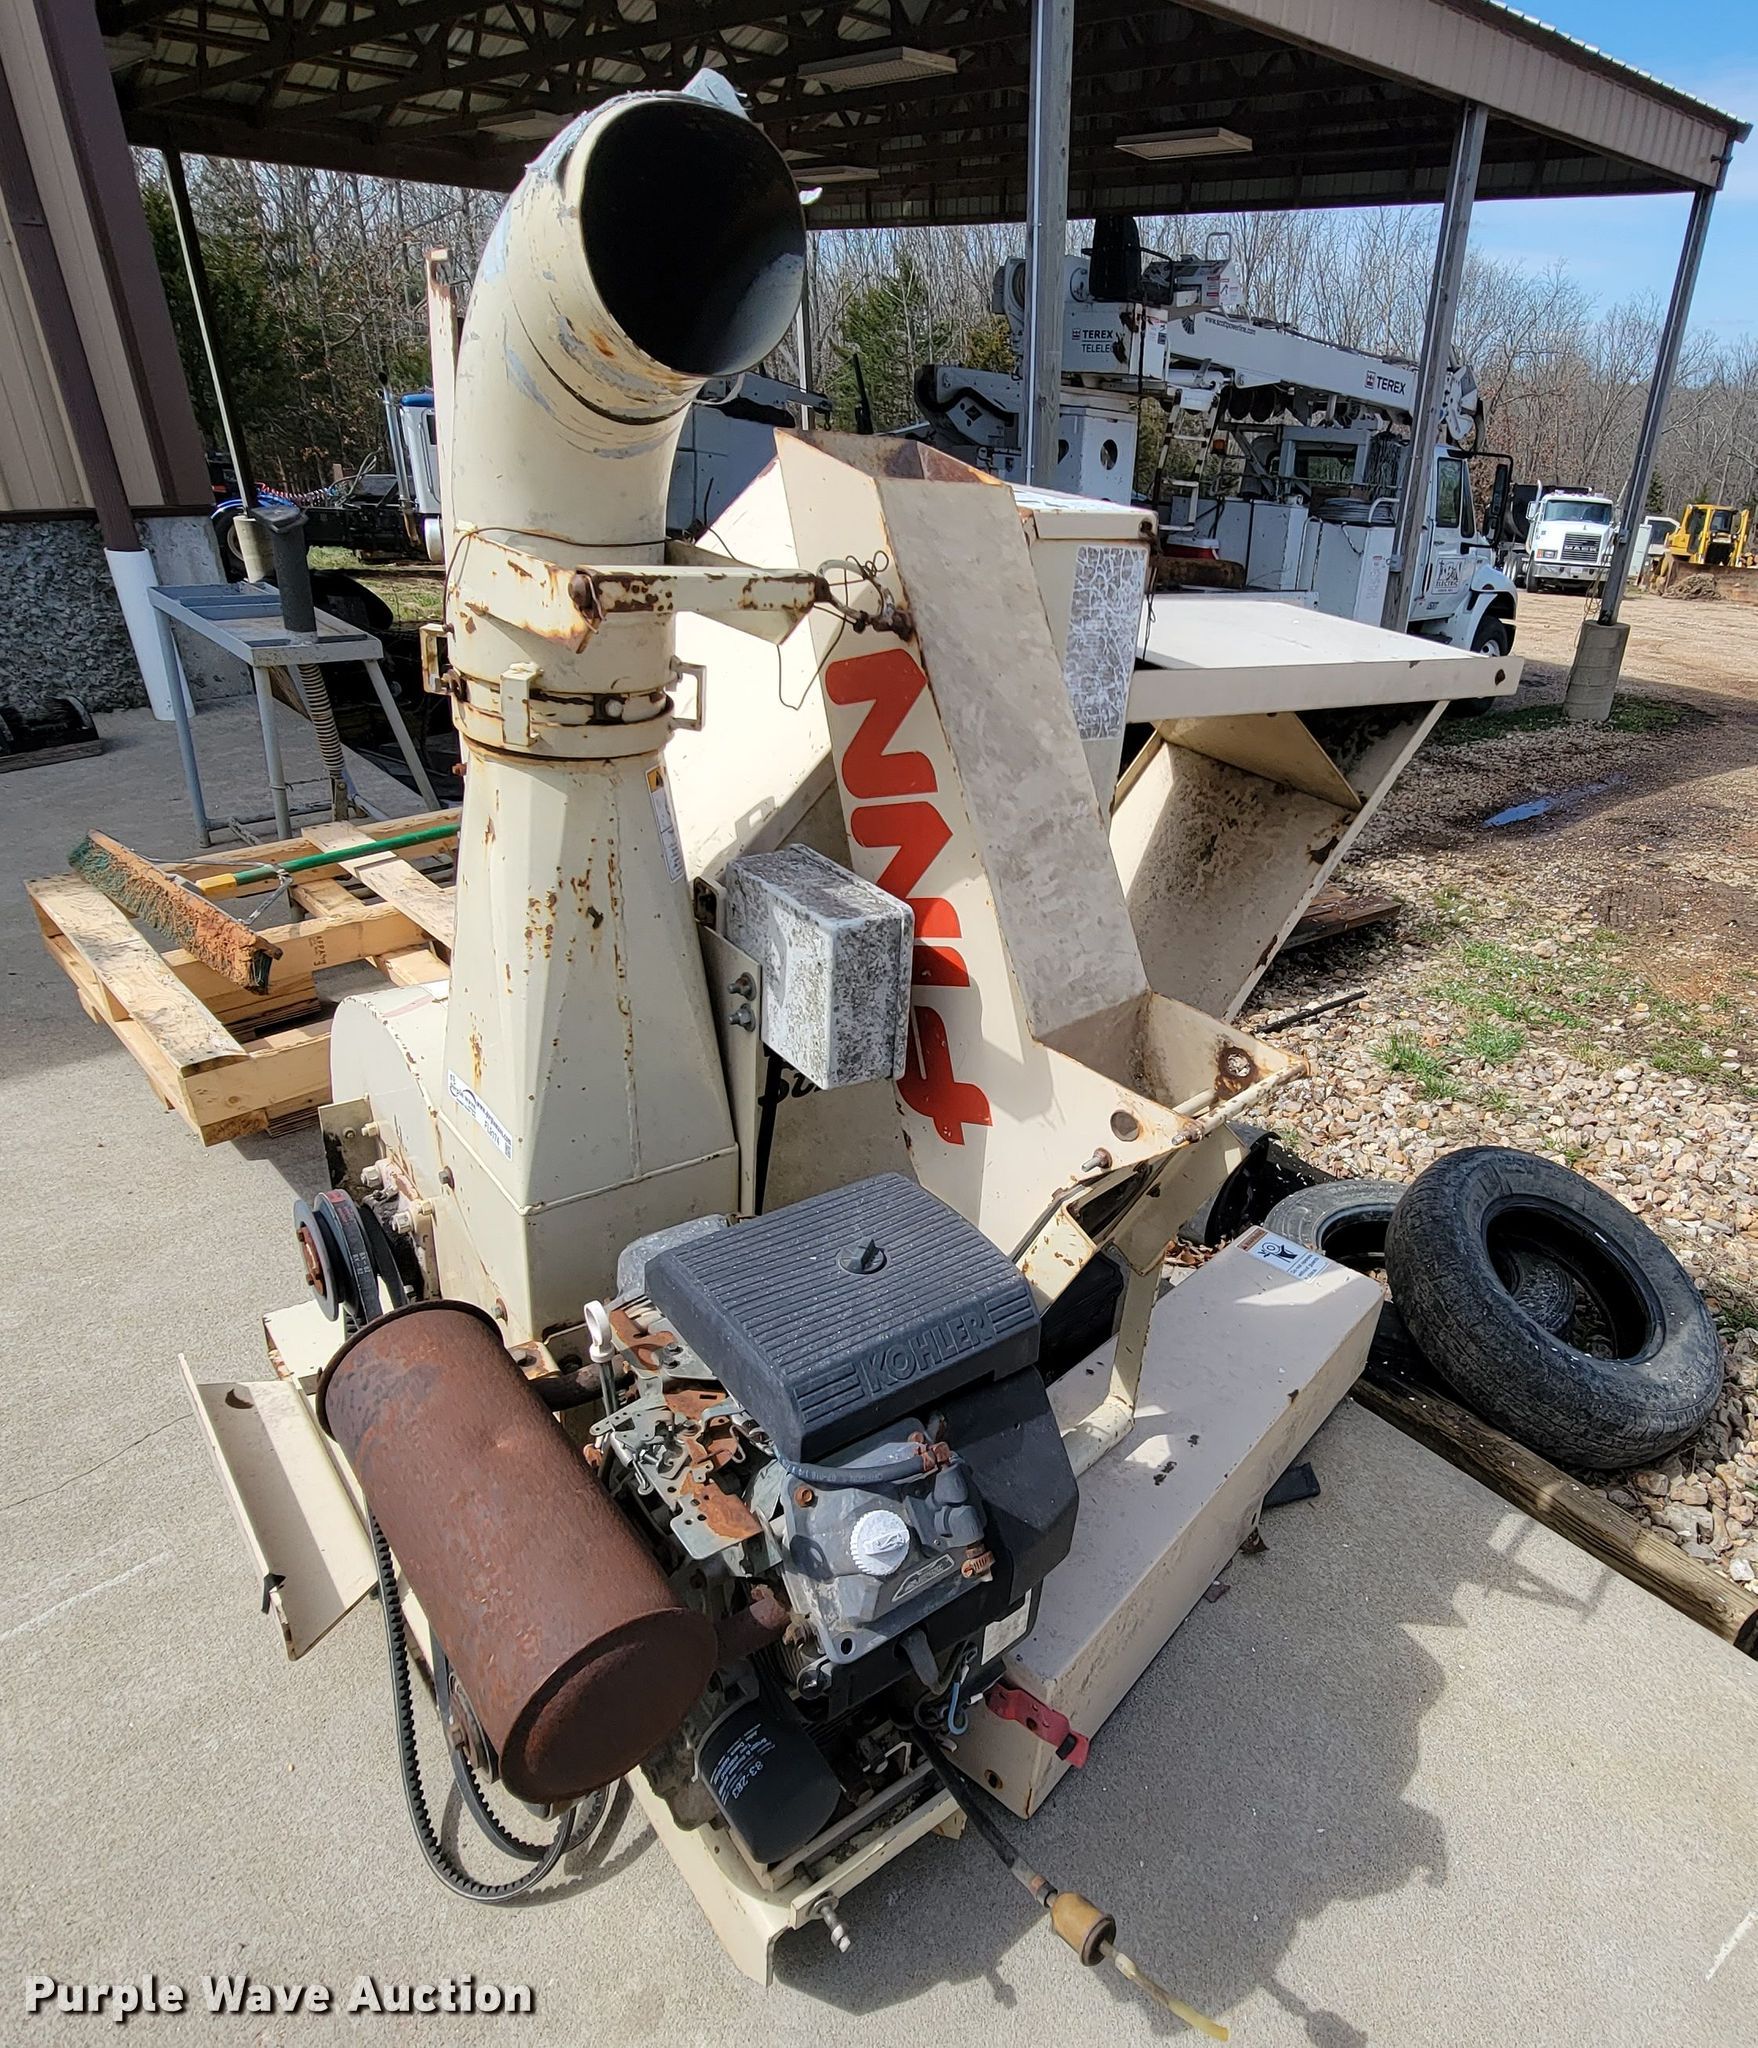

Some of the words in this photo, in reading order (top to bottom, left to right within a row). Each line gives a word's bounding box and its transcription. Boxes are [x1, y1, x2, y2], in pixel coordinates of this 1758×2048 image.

[1082, 329, 1114, 339] TEREX
[1081, 343, 1113, 353] TELELE
[1376, 375, 1406, 396] TEREX
[859, 1311, 994, 1397] KOHLER
[731, 1760, 764, 1800] 83-283
